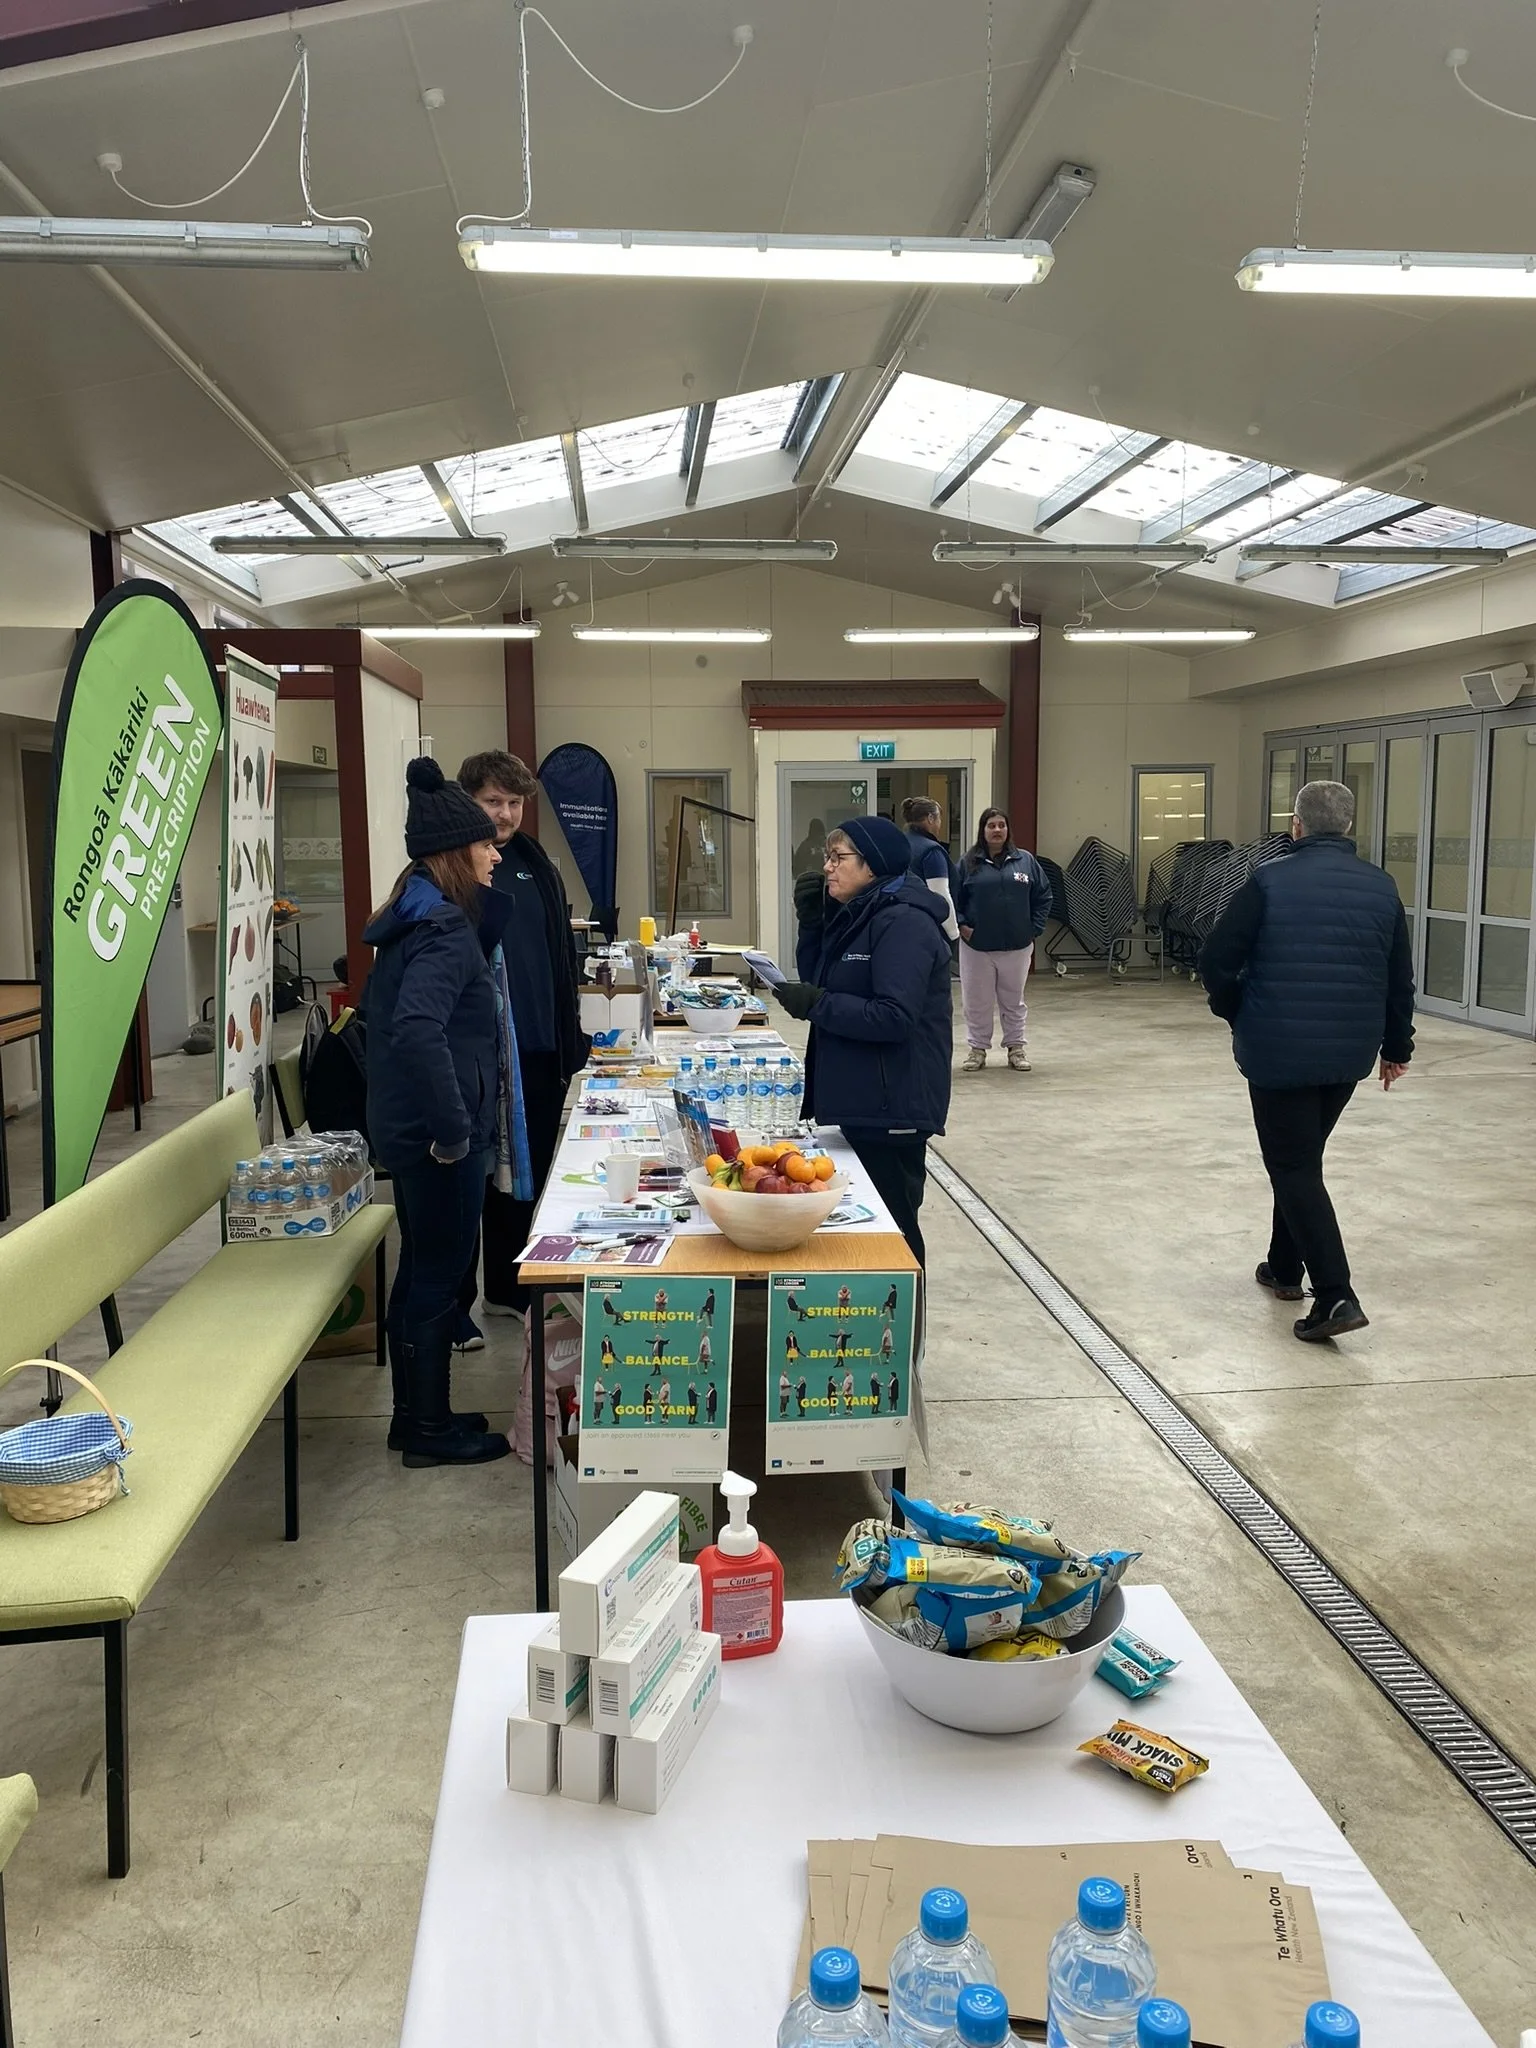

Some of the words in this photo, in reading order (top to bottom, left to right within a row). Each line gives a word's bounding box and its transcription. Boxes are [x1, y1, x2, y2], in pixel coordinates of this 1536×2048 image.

[866, 744, 890, 758] EXIT
[62, 804, 111, 923] Rongoā
[101, 685, 150, 805] Kākāriki
[87, 673, 195, 962] GREEN
[140, 717, 211, 920] PRESCRIPTION
[562, 811, 595, 820] available
[230, 1231, 259, 1239] 600mL
[623, 1311, 694, 1322] STRENGTH
[807, 1306, 877, 1317] STRENGTH
[554, 1337, 581, 1357] NIK
[809, 1348, 871, 1359] BALANCE
[625, 1355, 689, 1366] BALANCE
[800, 1397, 839, 1408] GOOD
[843, 1395, 878, 1406] YARN
[615, 1405, 655, 1415] GOOD
[659, 1405, 696, 1415] YARN
[680, 1496, 708, 1533] FIBRE
[729, 1576, 758, 1586] Cutan
[1130, 1740, 1183, 1768] SNACK
[1185, 1844, 1199, 1864] Ora
[1269, 1886, 1281, 1906] Ora
[1272, 1908, 1288, 1942] Whatu
[1277, 1946, 1291, 1960] Te
